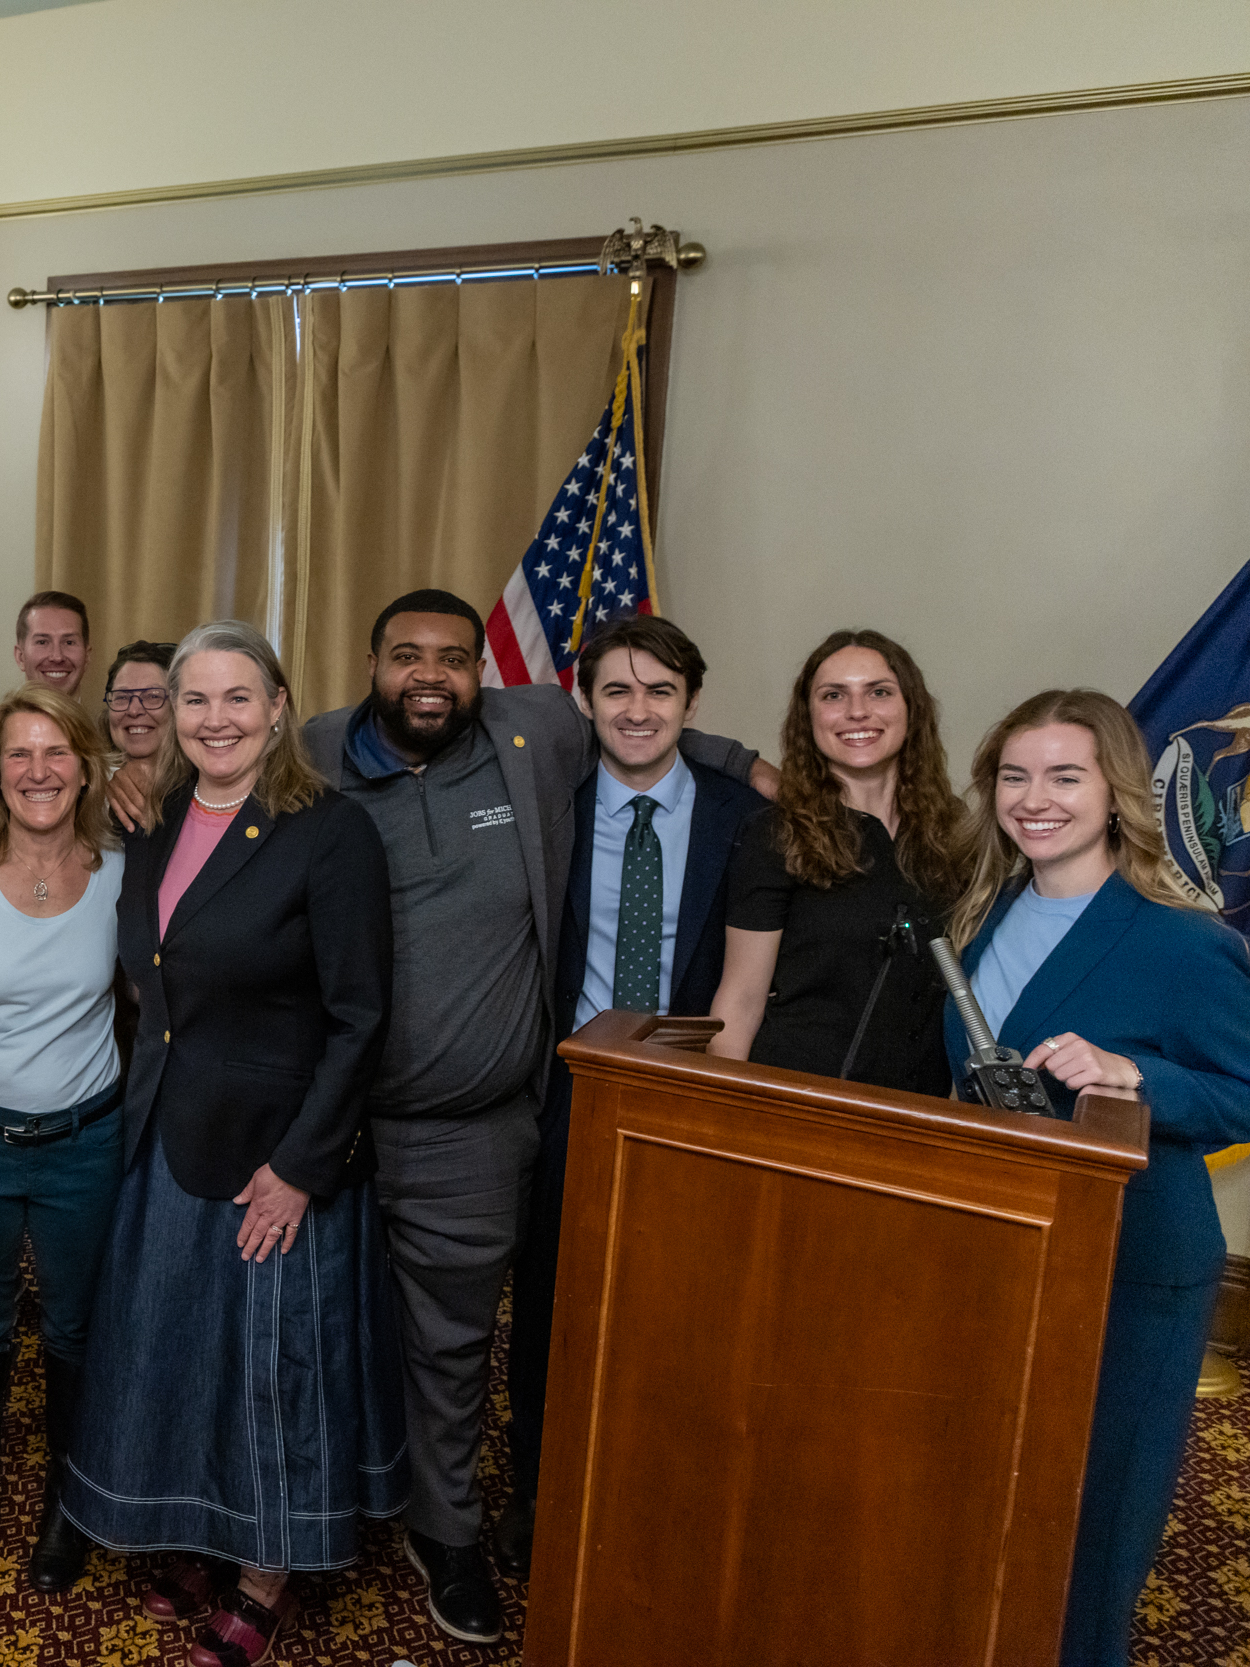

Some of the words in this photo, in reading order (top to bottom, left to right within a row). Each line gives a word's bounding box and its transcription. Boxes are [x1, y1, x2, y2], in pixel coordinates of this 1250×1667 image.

[1182, 753, 1191, 763] SI
[470, 809, 486, 818] JOBS
[486, 808, 495, 817] for
[471, 821, 492, 830] powered
[1180, 813, 1207, 871] PENINSULAM
